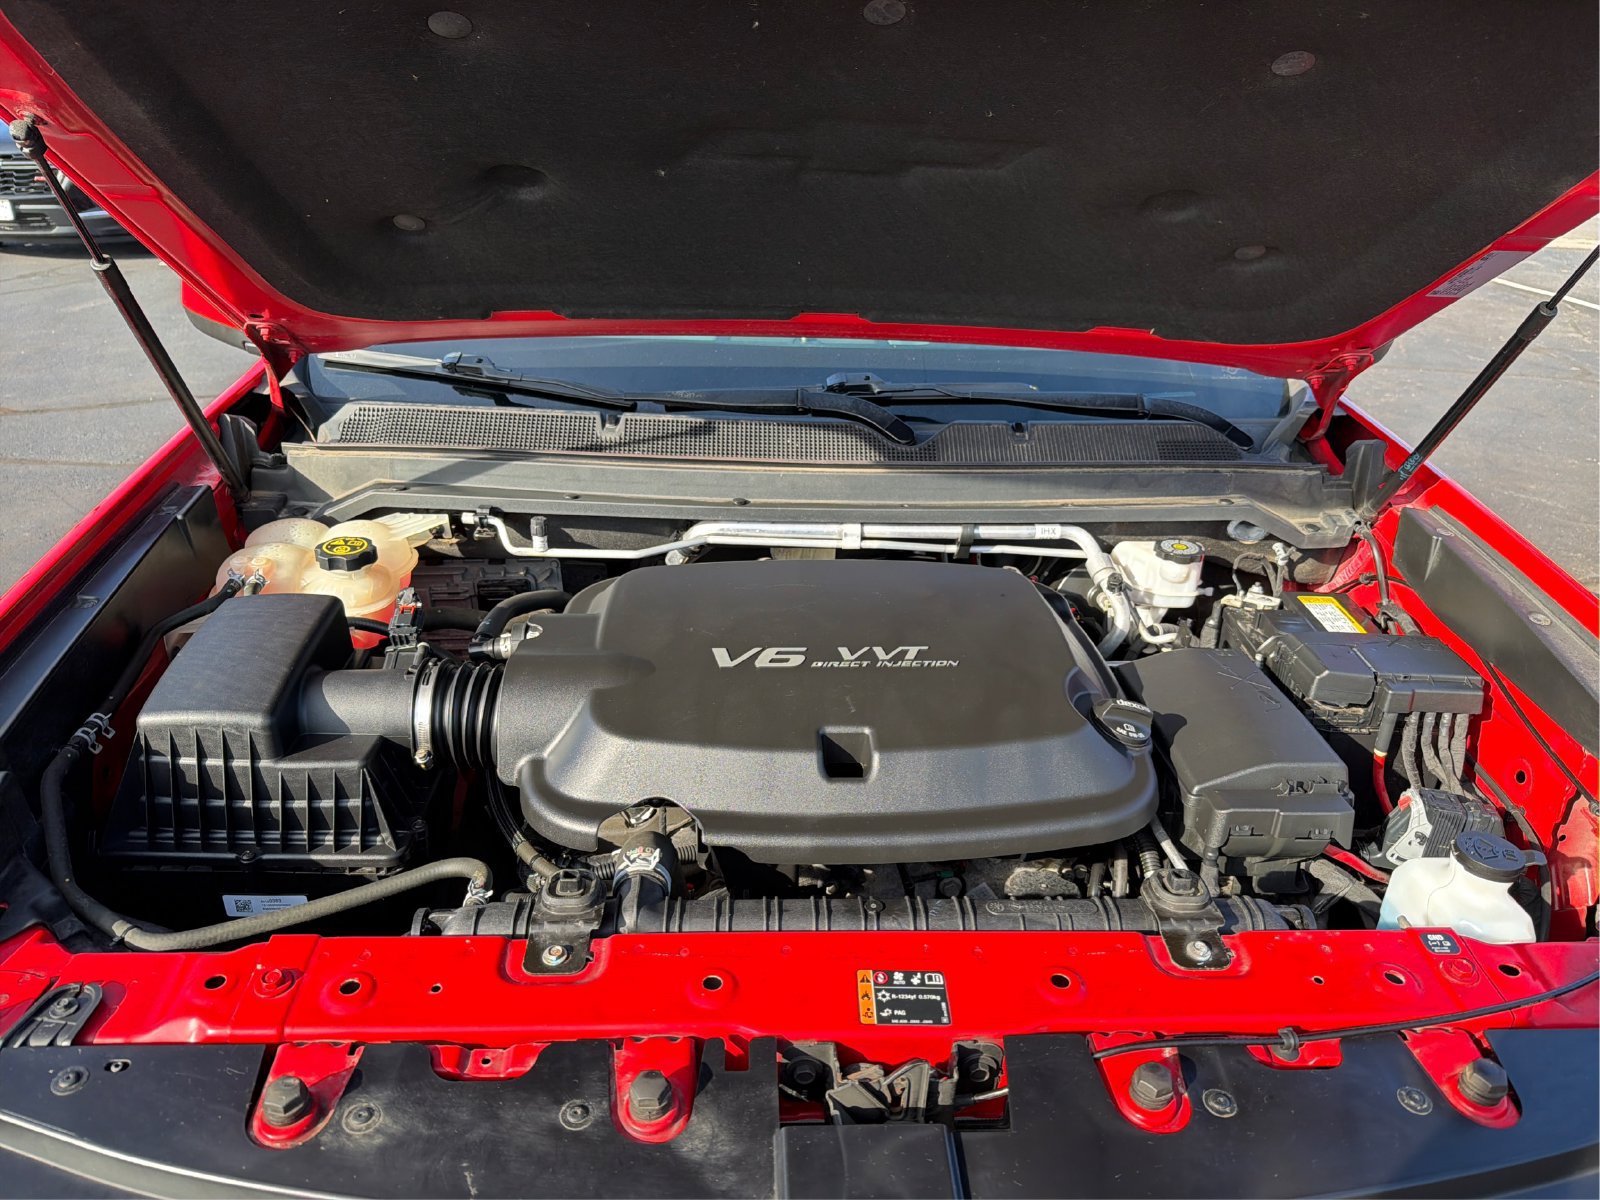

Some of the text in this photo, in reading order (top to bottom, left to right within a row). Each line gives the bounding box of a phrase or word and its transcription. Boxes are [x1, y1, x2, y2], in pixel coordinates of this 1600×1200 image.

[711, 646, 930, 669] V6 VVT
[811, 660, 960, 668] DIRECT INJECTION
